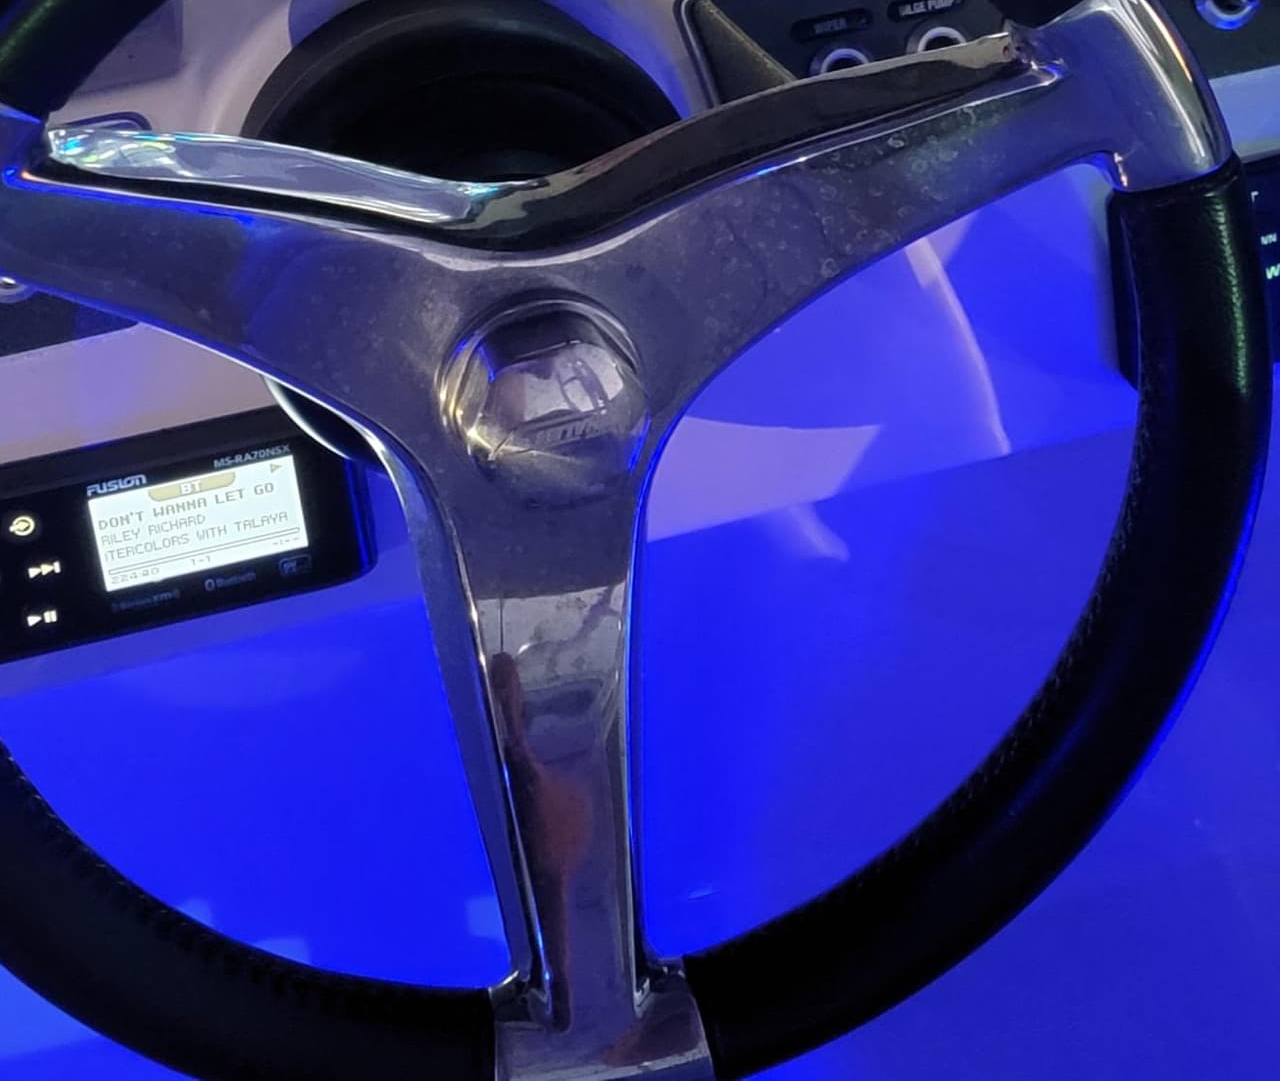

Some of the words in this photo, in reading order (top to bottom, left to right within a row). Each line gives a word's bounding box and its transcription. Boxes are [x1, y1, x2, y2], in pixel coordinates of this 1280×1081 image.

[214, 444, 291, 469] MS-RA70NSX
[180, 480, 203, 495] BT
[98, 510, 144, 531] DON'T
[153, 497, 208, 518] WANNA
[215, 487, 245, 505] LET
[254, 482, 275, 496] GO
[101, 528, 140, 547] RILEY
[148, 514, 206, 536] RICHARD
[197, 524, 228, 542] WITH
[234, 511, 289, 531] TALAYA
